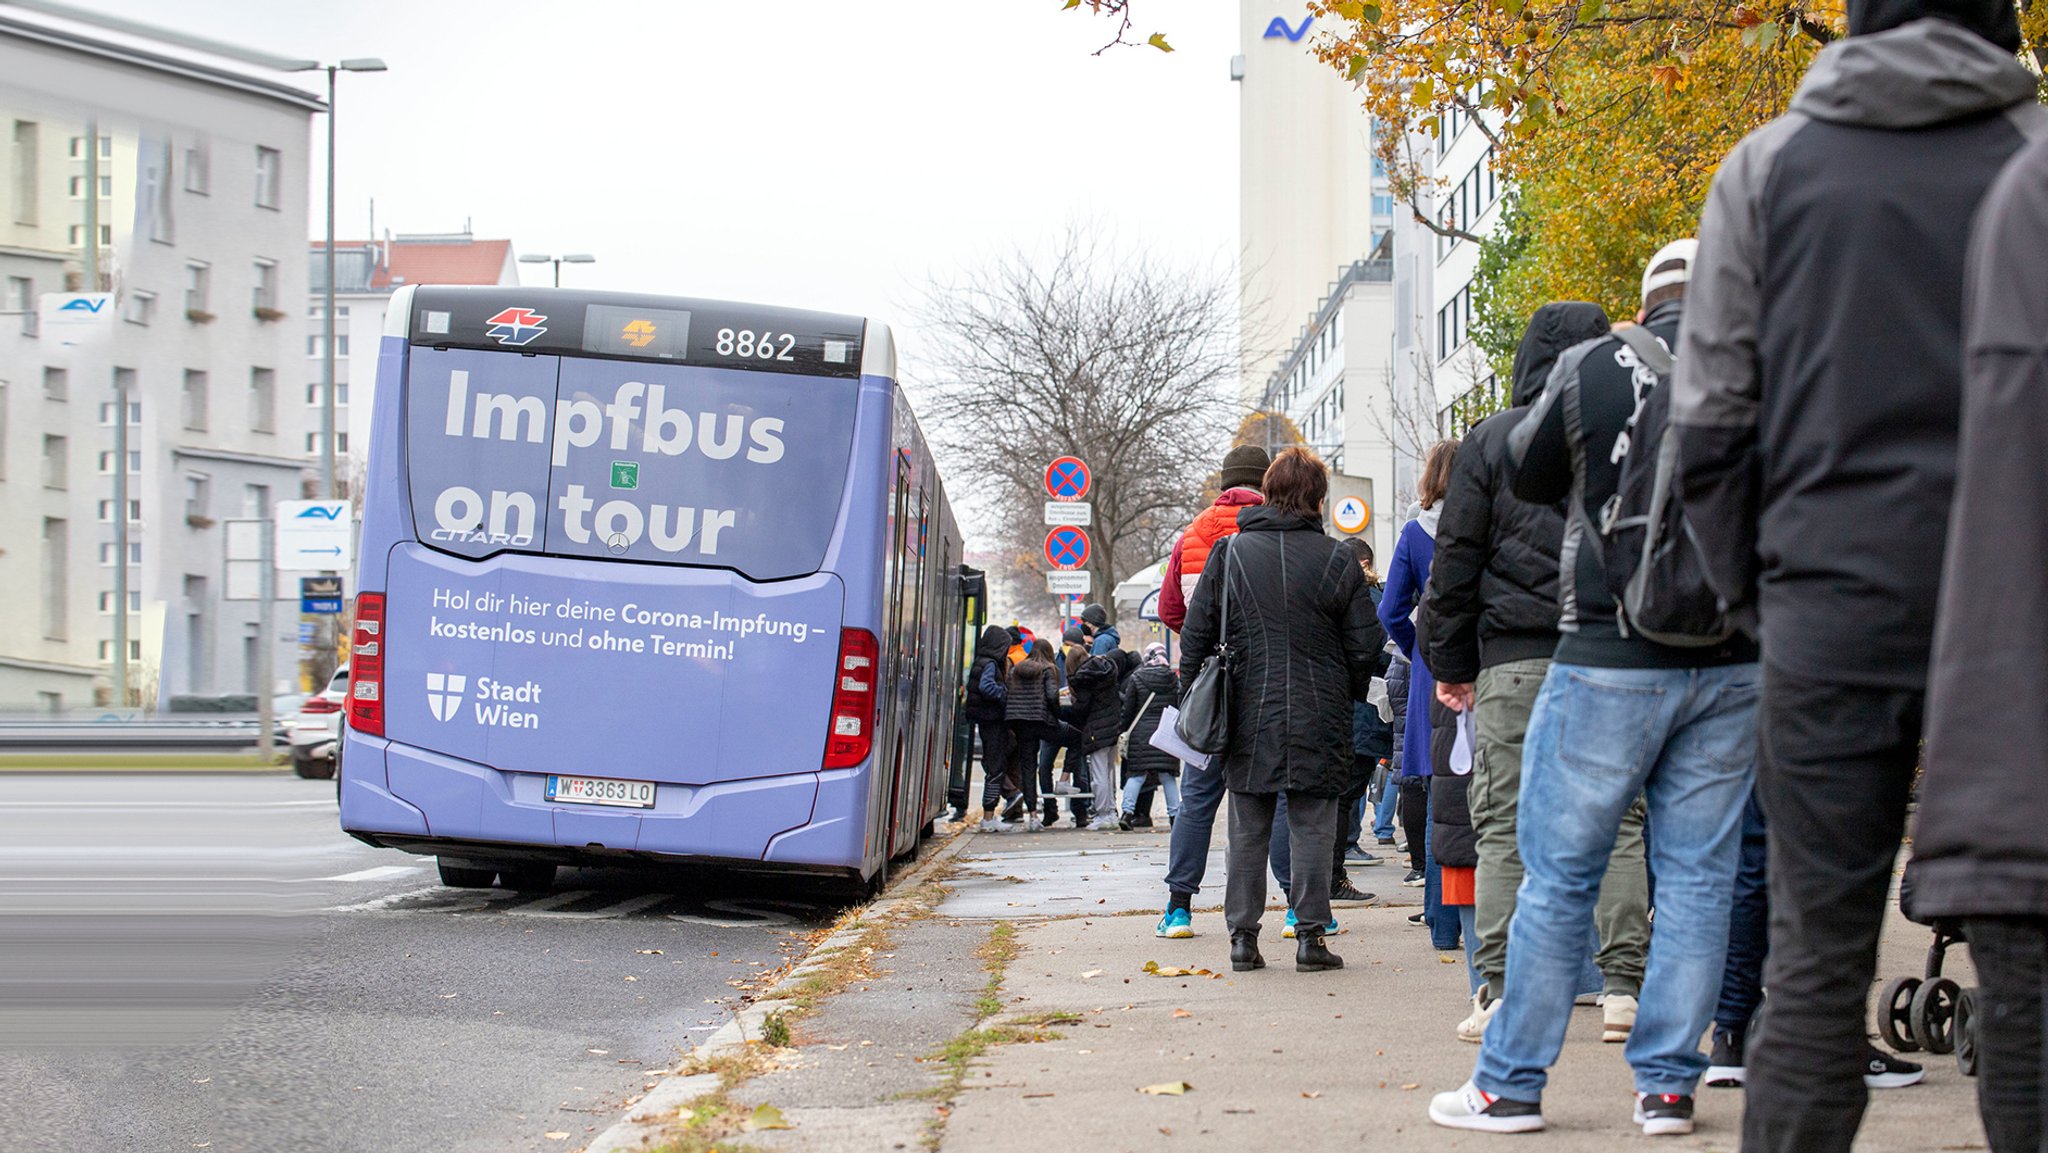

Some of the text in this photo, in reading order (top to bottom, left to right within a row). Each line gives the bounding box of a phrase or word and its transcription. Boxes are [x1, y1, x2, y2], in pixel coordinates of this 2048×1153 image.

[716, 328, 796, 361] 8862
[445, 370, 785, 467] Impfbus
[434, 484, 736, 555] on tour
[430, 528, 534, 546] CITARO
[432, 588, 470, 610] Hol
[475, 591, 505, 613] dir
[509, 593, 552, 616] hier
[556, 598, 616, 622] deine
[621, 603, 808, 643] Corona-Impfung
[430, 616, 735, 661] kostenlos und ohne Termin!
[476, 677, 542, 703] Stadt
[475, 702, 539, 729] Wien
[585, 781, 626, 798] 3363
